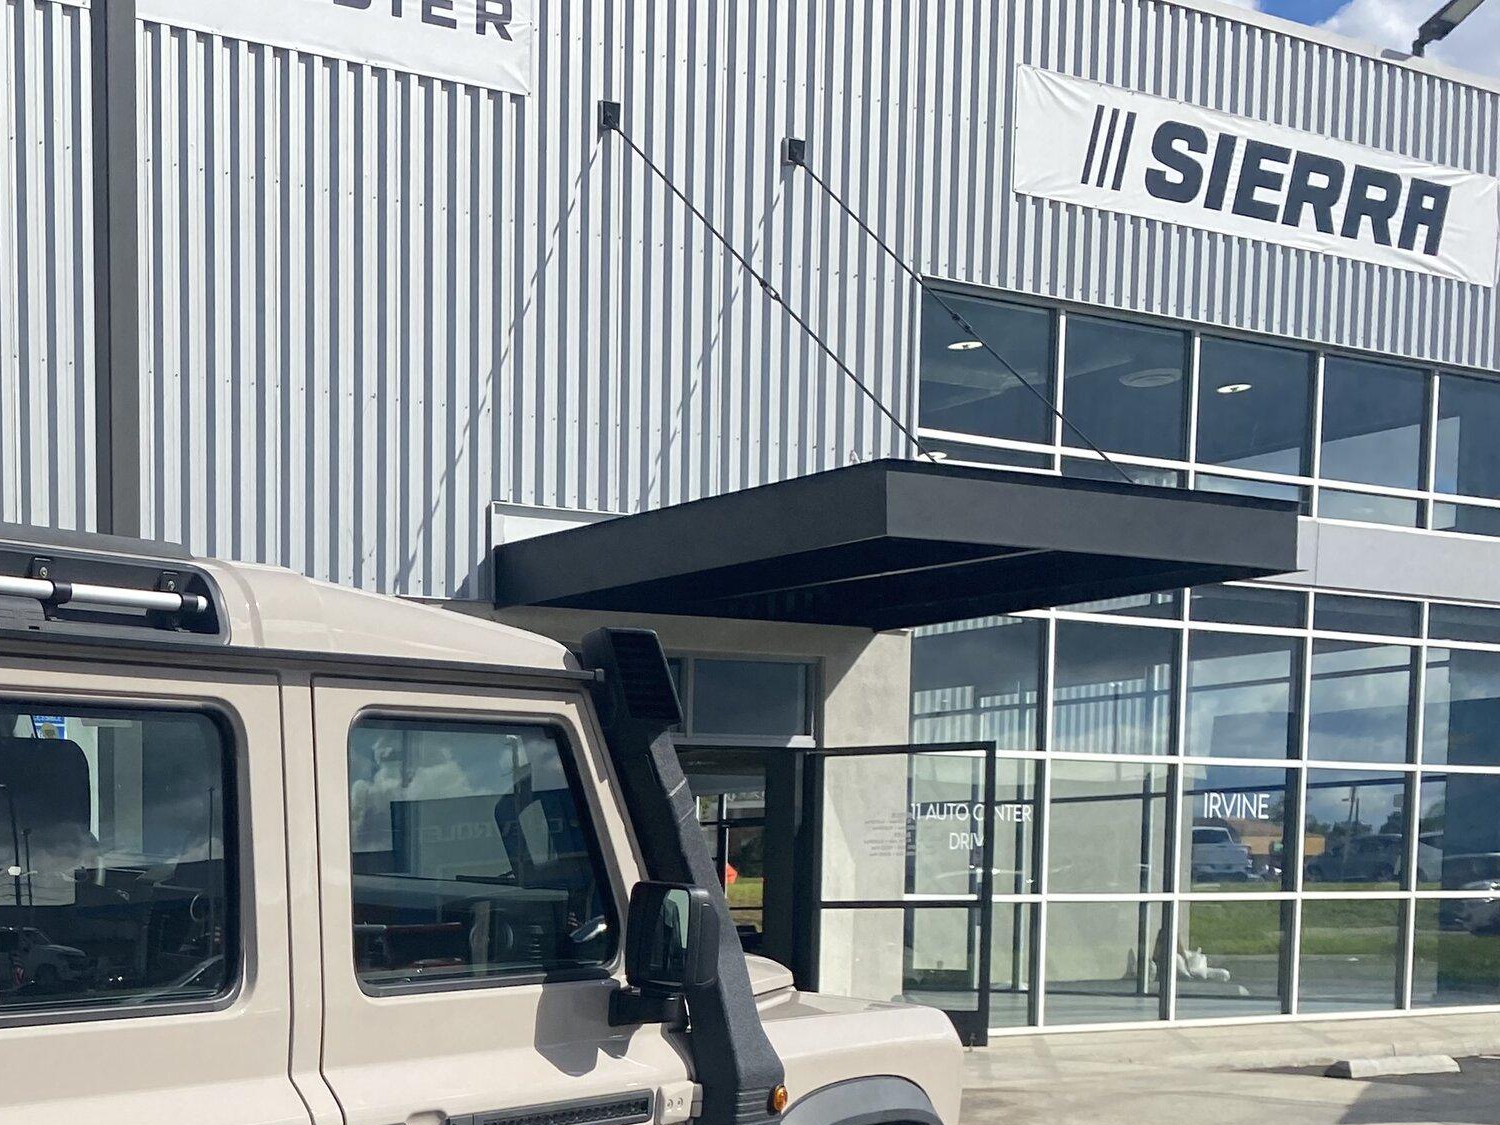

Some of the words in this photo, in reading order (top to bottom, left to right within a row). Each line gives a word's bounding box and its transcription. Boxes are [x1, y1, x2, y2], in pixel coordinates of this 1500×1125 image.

[1145, 120, 1452, 257] SIERRA
[911, 803, 921, 820] 11
[926, 803, 969, 821] AUTO
[973, 803, 1032, 822] CNTER
[1203, 792, 1270, 820] IRVINE
[949, 832, 985, 850] DRIV
